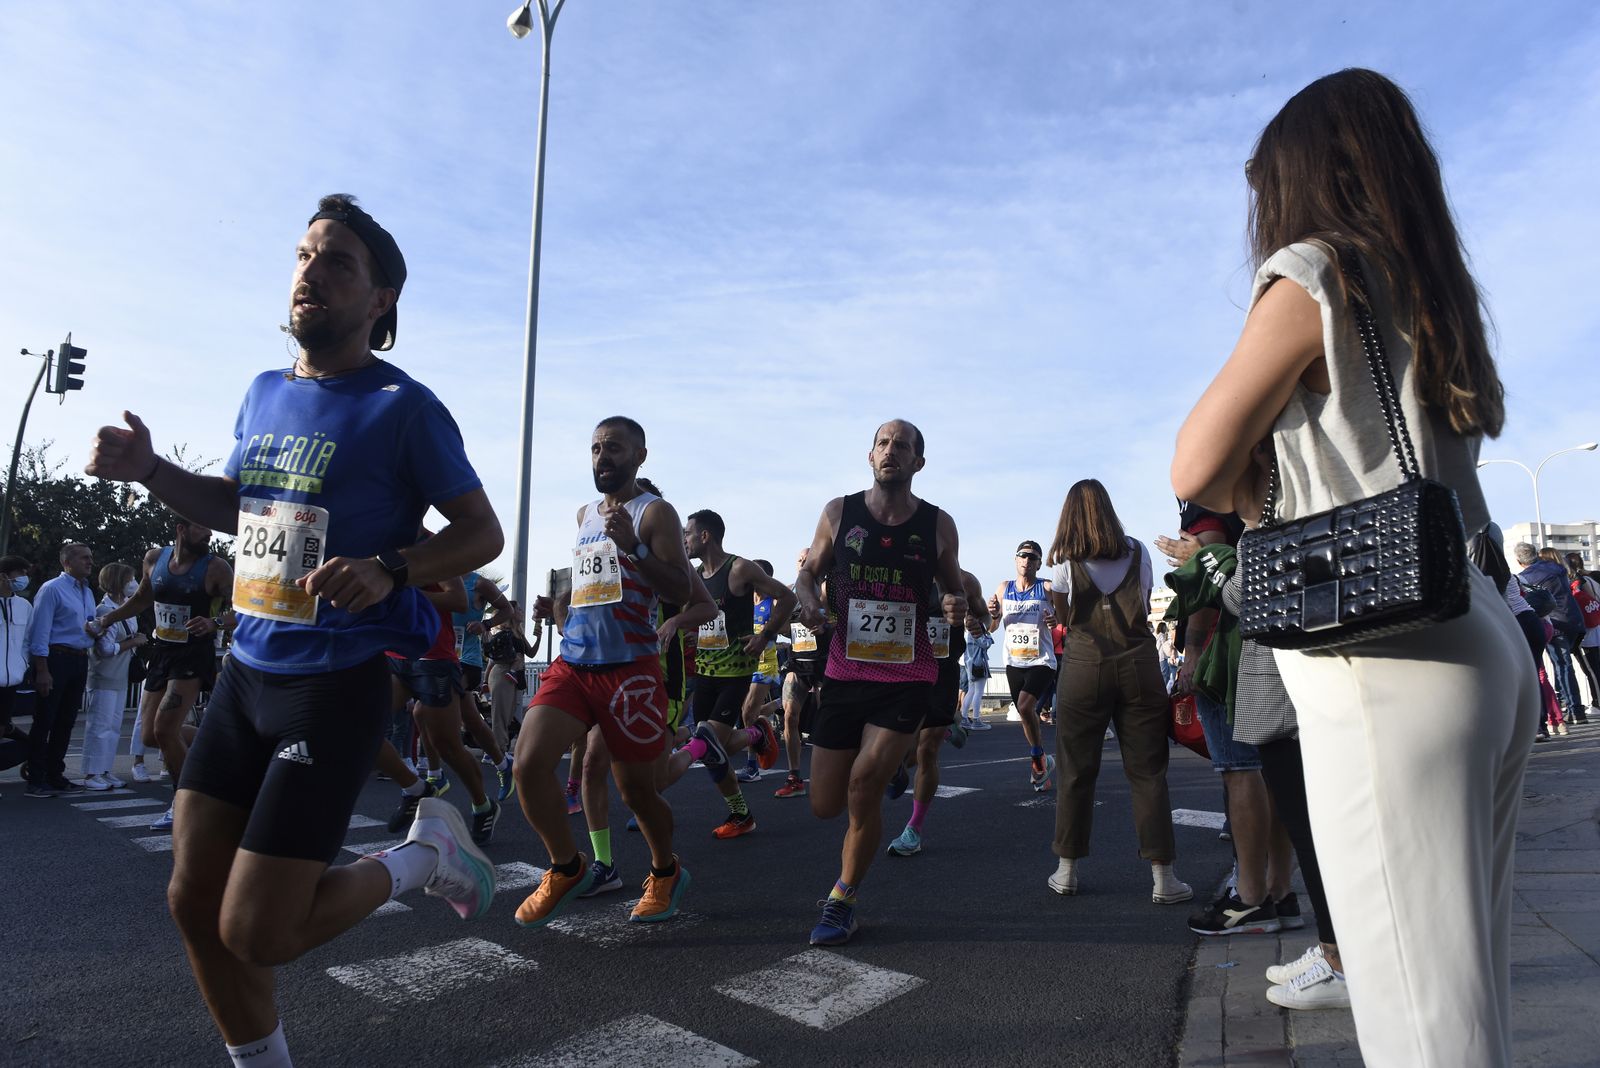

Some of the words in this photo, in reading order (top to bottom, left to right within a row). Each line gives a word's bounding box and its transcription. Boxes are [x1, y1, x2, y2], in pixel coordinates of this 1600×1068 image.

[273, 432, 337, 478] GAÏA
[294, 509, 317, 526] edp
[242, 525, 287, 562] 284
[579, 556, 602, 577] 438
[864, 565, 888, 583] COSTA
[892, 568, 902, 585] DE
[1584, 600, 1600, 614] edp
[158, 611, 177, 624] 116
[701, 620, 714, 630] 59
[860, 614, 897, 634] 273
[1012, 634, 1029, 645] 239
[278, 751, 314, 765] adidas
